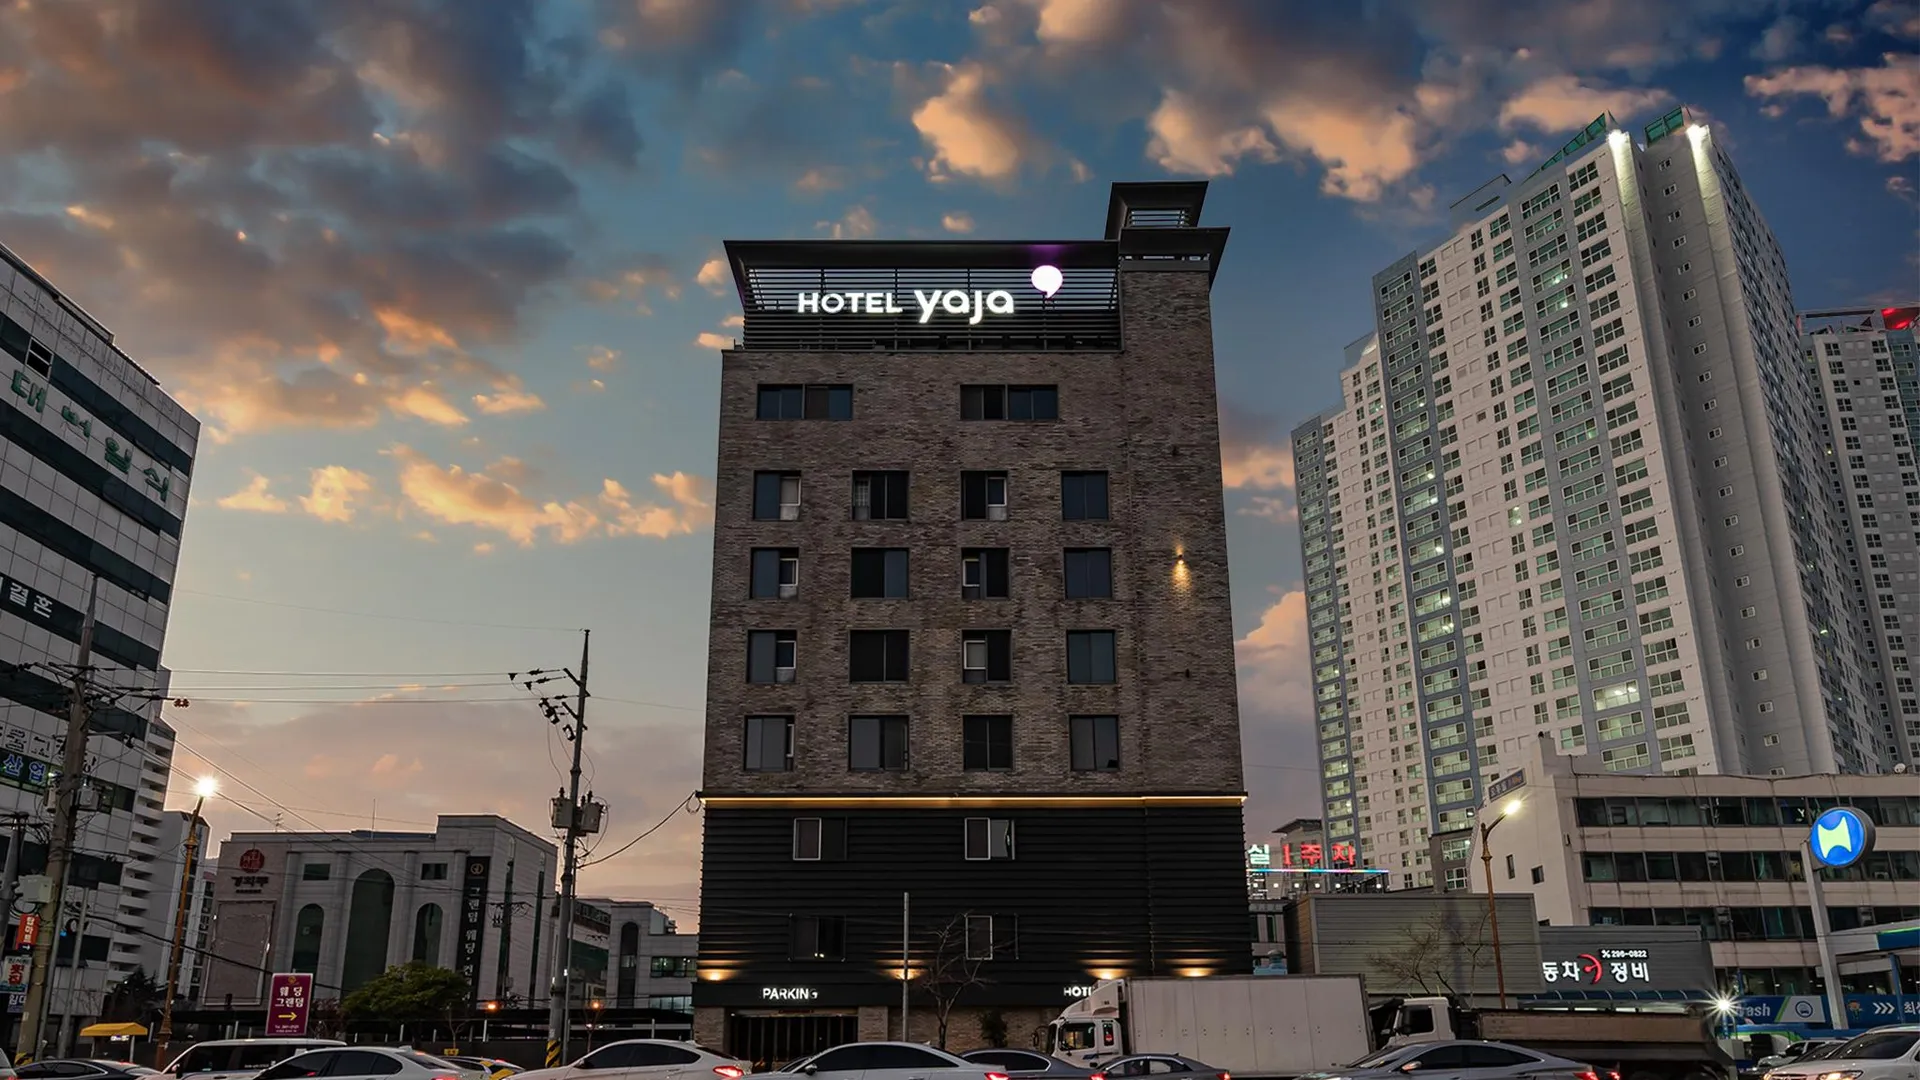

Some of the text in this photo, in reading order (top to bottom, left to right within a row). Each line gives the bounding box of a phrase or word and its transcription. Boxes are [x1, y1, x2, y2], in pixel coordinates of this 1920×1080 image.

[797, 289, 1015, 325] HOTEL yaja
[0, 576, 53, 619] 결혼
[1542, 960, 1650, 983] 동차 정비
[762, 987, 818, 1000] PARKING
